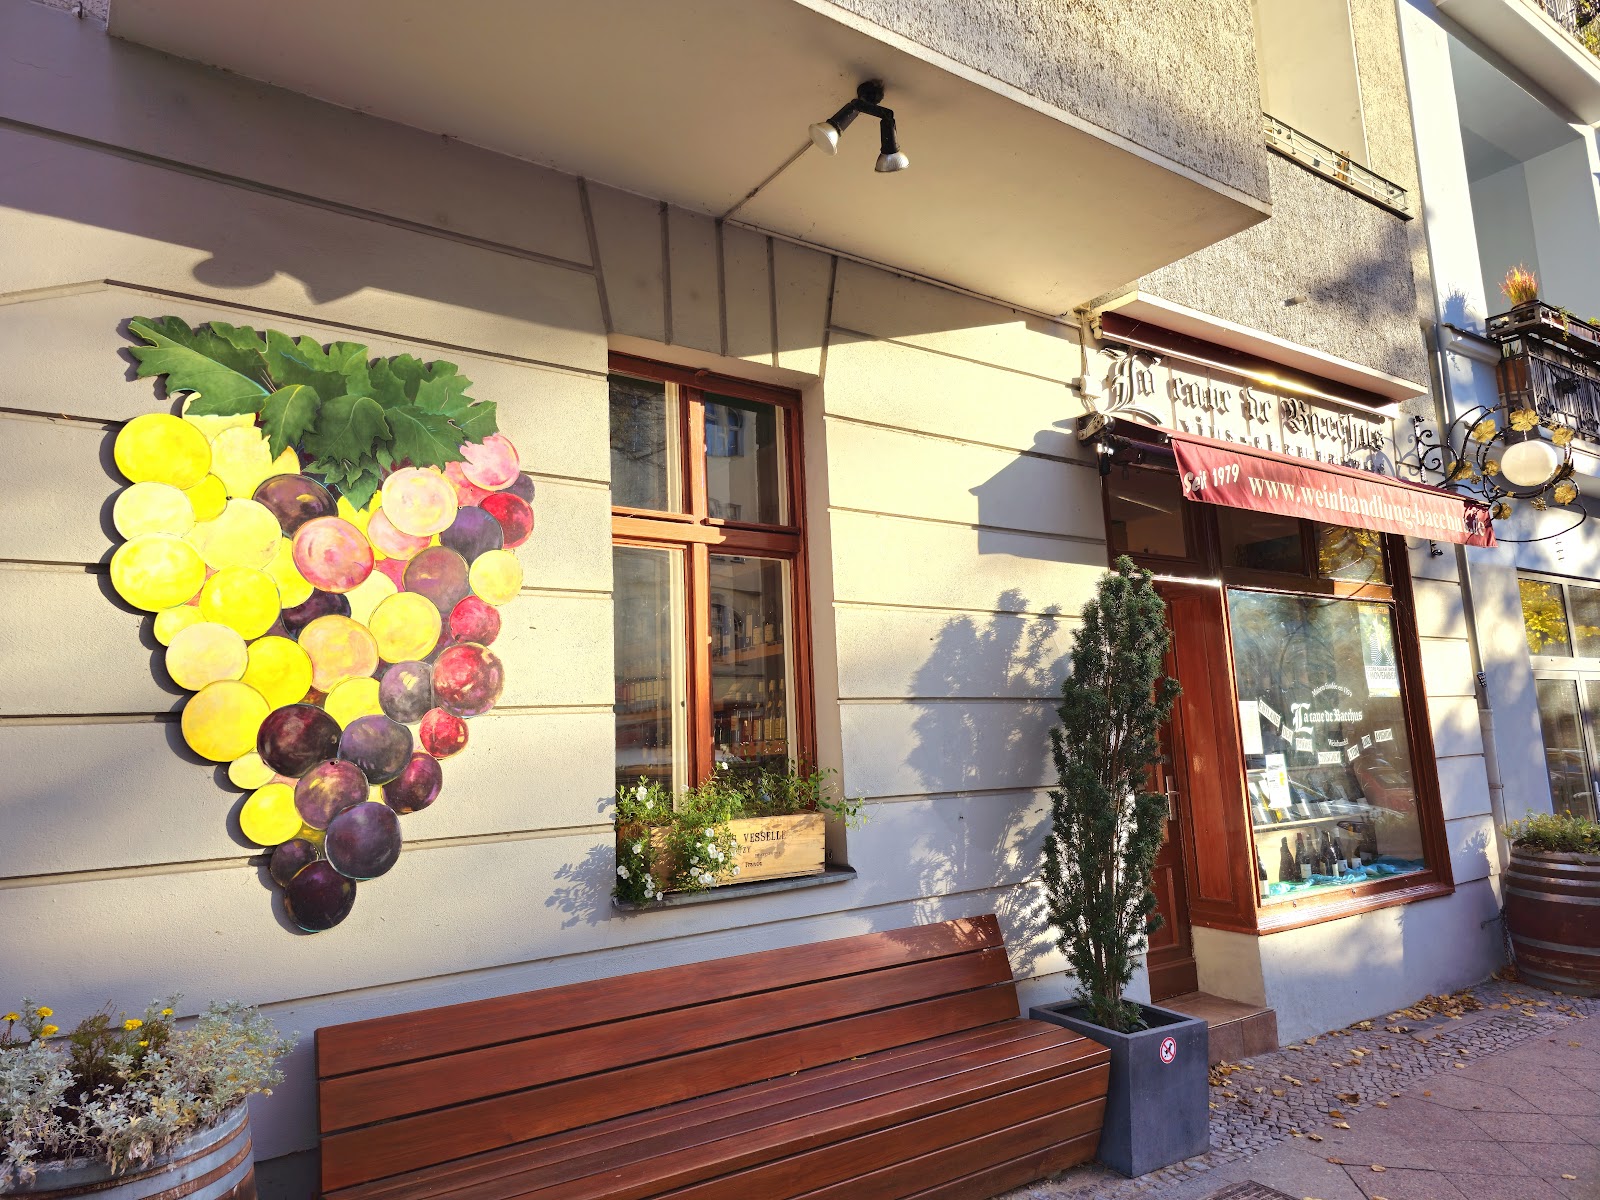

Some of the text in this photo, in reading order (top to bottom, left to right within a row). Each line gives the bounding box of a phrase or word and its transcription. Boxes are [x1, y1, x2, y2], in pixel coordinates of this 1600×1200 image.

[1241, 386, 1271, 424] de
[1184, 463, 1239, 493] Seit 1979
[1248, 477, 1485, 537] www.weinhandlung-bacchus.de
[1290, 703, 1363, 735] La cave de Bacchus
[743, 830, 787, 843] VESSELLE
